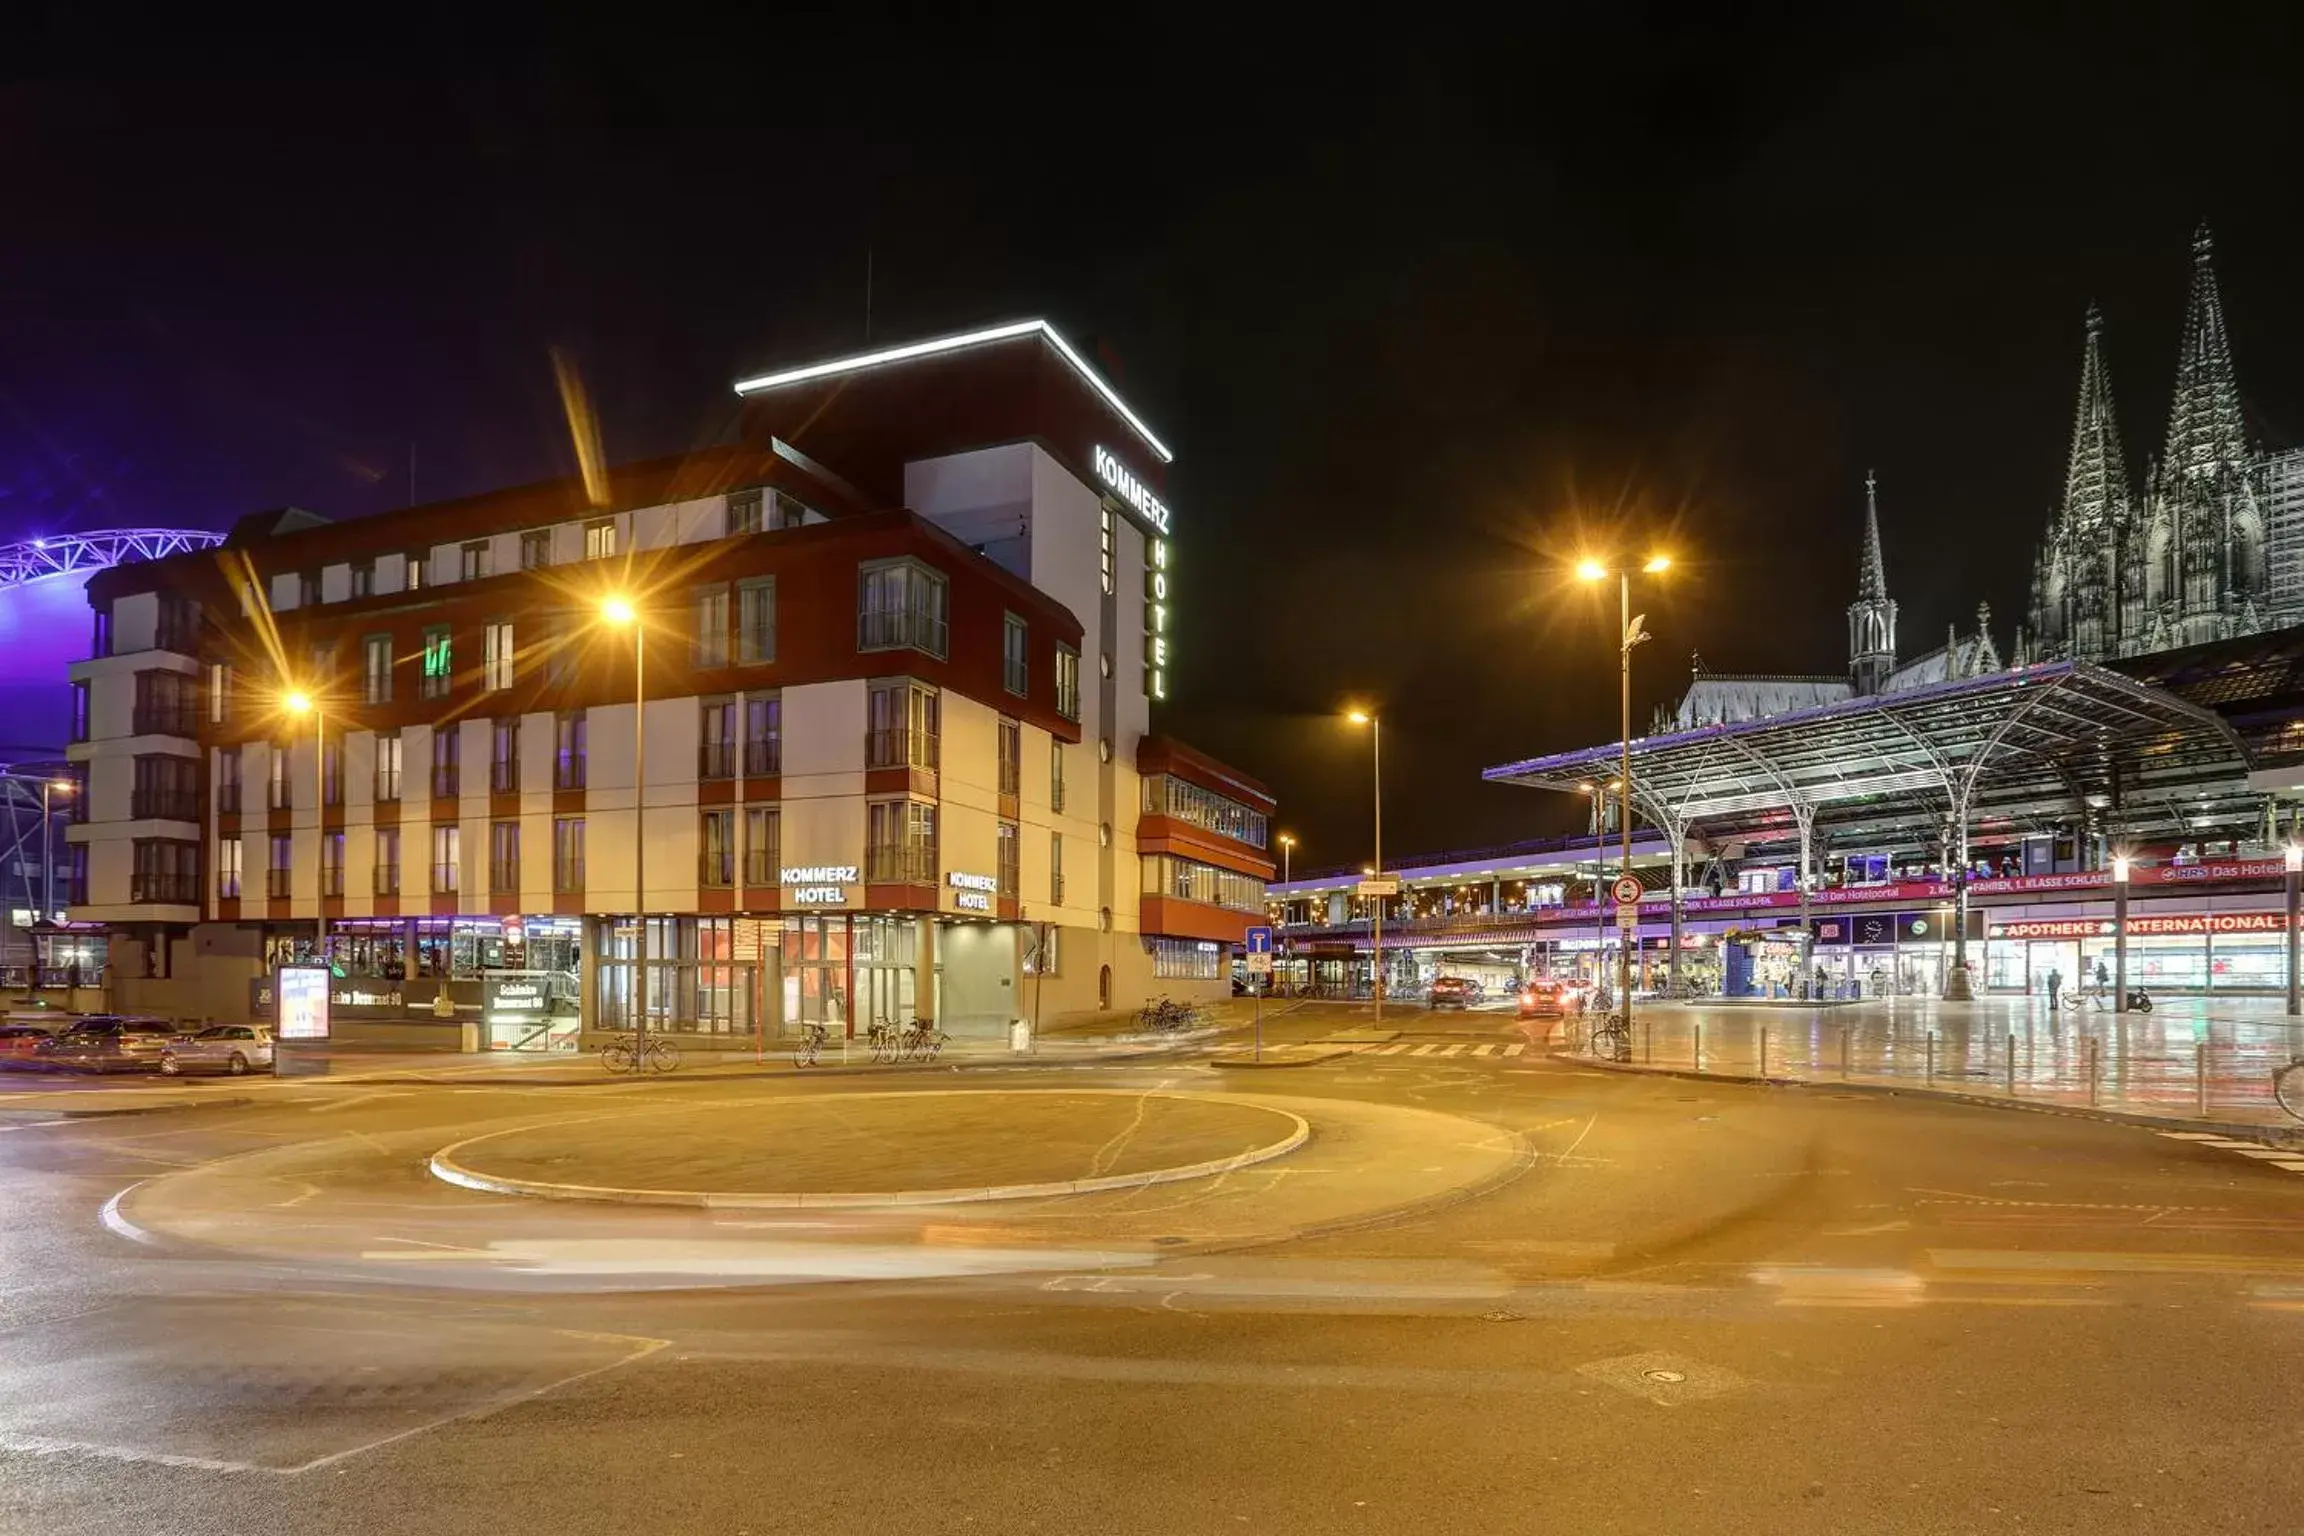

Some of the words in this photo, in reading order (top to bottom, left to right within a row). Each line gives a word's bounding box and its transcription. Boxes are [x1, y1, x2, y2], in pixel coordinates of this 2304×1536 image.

[1095, 444, 1170, 535] KOMMERZ
[1154, 538, 1166, 699] HOTEL
[781, 866, 858, 884] KOMMERZ
[2212, 866, 2238, 877] Das
[949, 871, 997, 891] KOMMERZ
[2026, 875, 2063, 889] KLASSE
[794, 887, 847, 904] HOTEL
[958, 893, 990, 910] HOTEL
[2006, 922, 2096, 937] APOTHEKE
[2125, 916, 2279, 933] NTERNATIONAL
